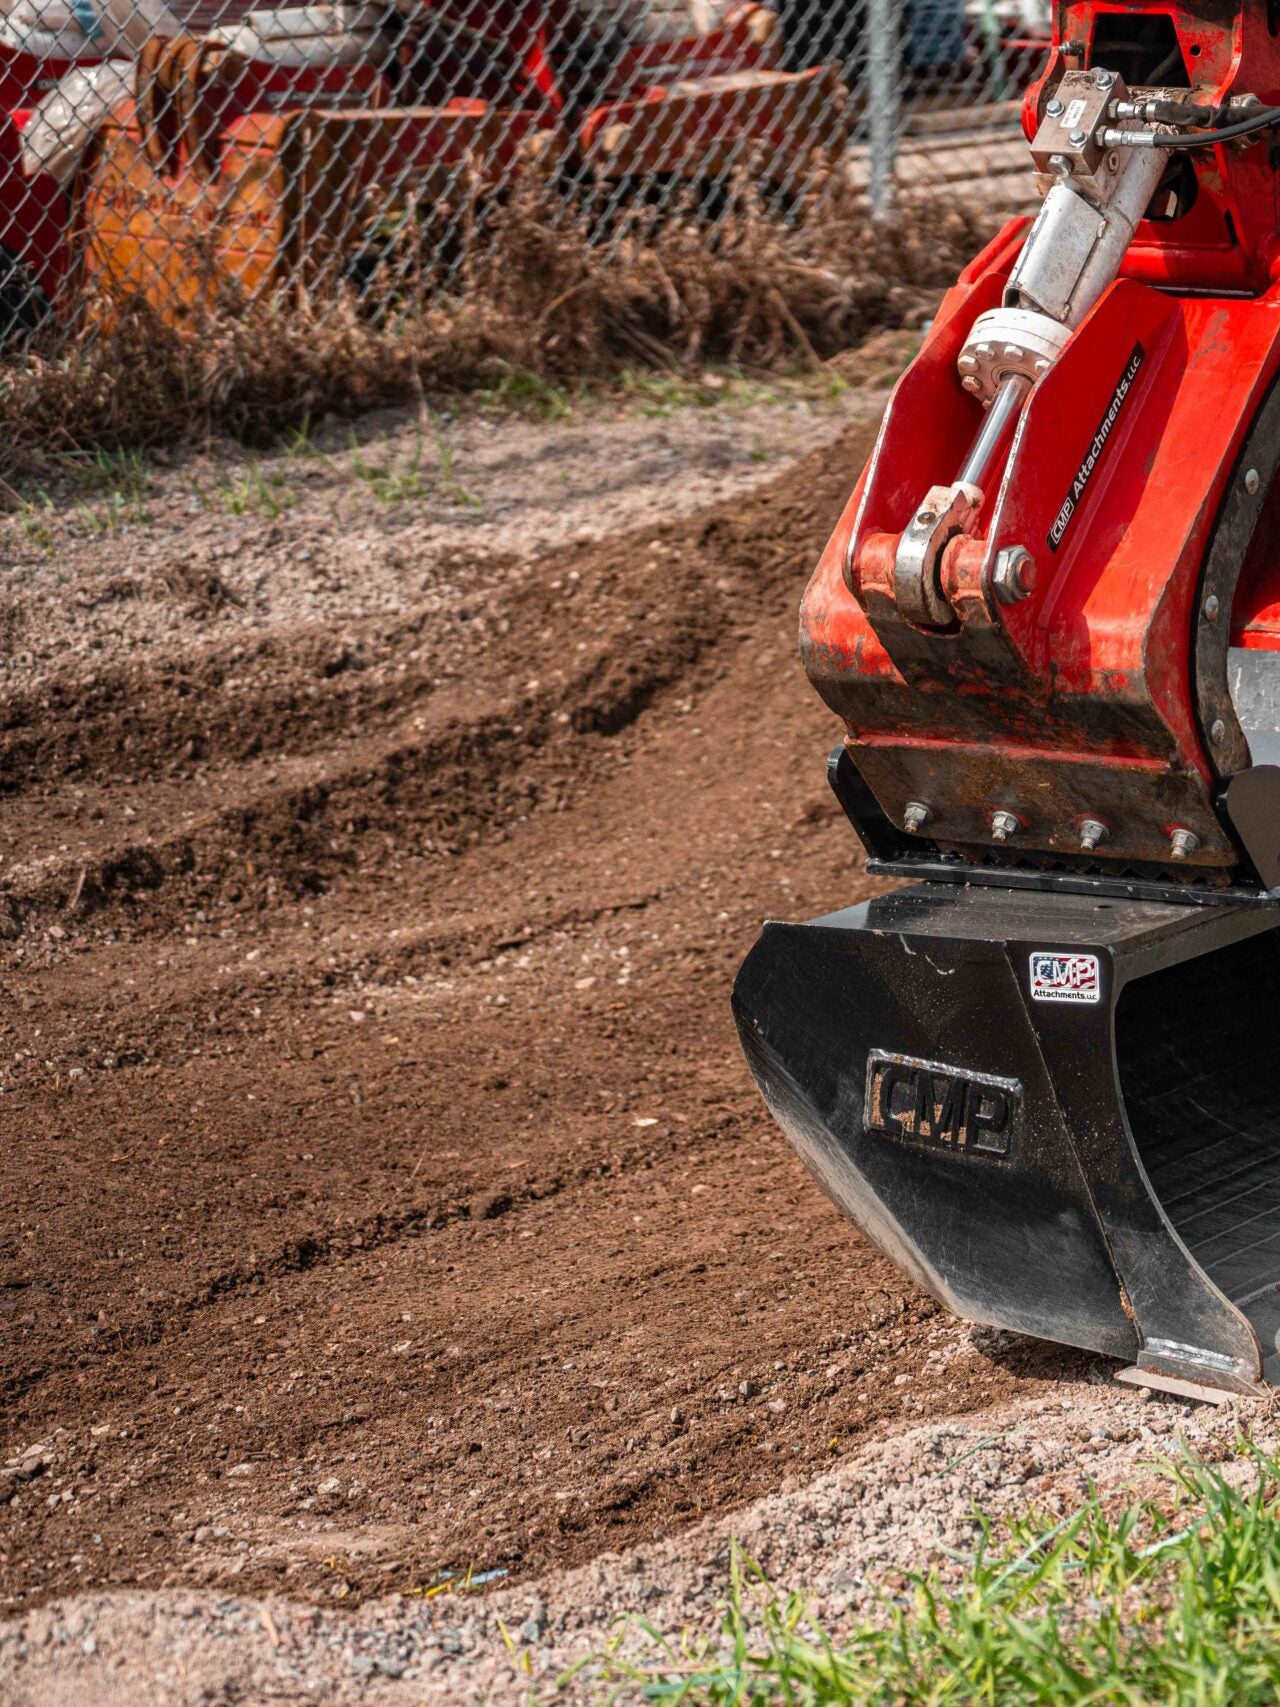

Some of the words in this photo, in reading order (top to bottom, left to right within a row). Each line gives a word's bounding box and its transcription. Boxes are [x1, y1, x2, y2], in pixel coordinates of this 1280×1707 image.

[1053, 502, 1072, 539] CMP
[1036, 959, 1092, 986] CMP
[879, 1062, 1012, 1152] CMP
